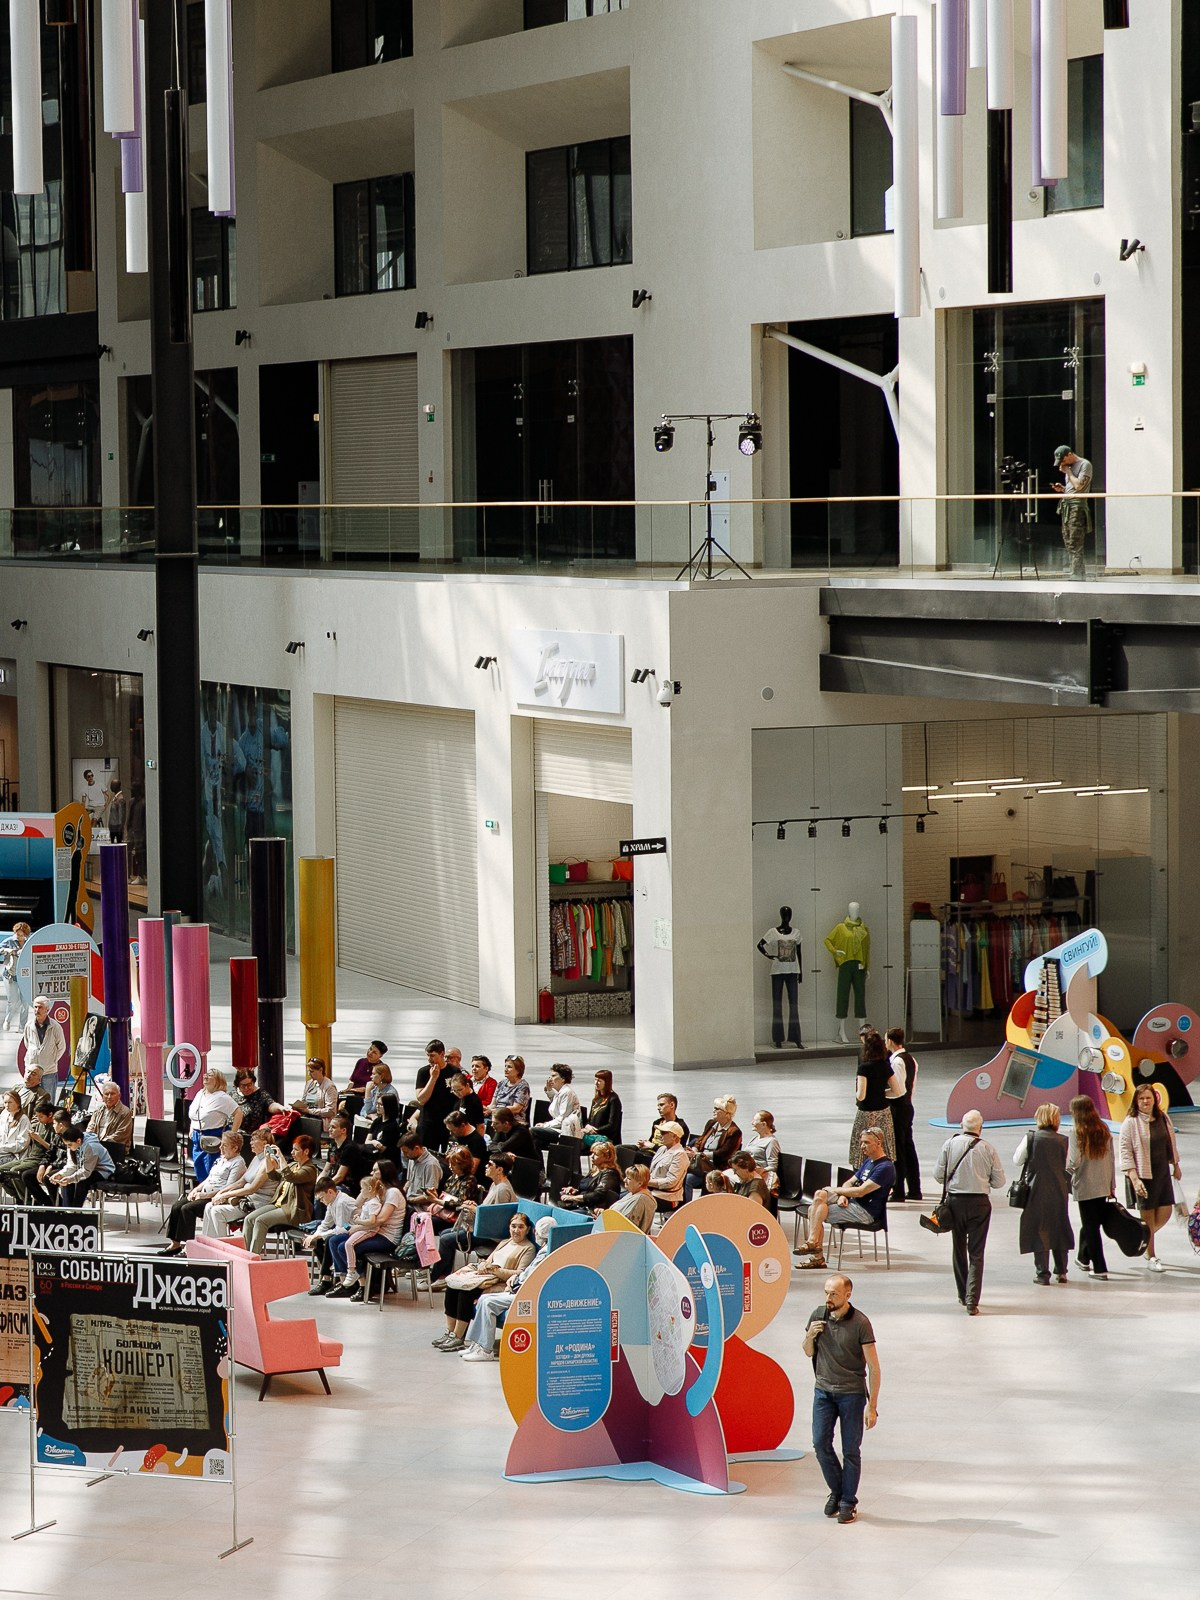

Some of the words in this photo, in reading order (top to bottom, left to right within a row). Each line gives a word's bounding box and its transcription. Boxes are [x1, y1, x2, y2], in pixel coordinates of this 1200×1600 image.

[1, 823, 19, 832] ДЖАЗ!
[1063, 935, 1098, 963] СВИНГУЙ!
[8, 1212, 98, 1256] Джаза
[60, 1260, 134, 1283] СОБЫТИЯ
[133, 1263, 227, 1309] Джаза
[547, 1300, 563, 1309] КЛУБ
[90, 1319, 113, 1329] КЛУБ
[514, 1333, 527, 1343] 60
[116, 1339, 162, 1350] БОЛЬШОЙ
[555, 1344, 564, 1353] ДК
[565, 1342, 596, 1352] «РОДИНА»
[103, 1348, 175, 1381] КОНЦЕРТ
[122, 1405, 160, 1415] ТАНЦЫ
